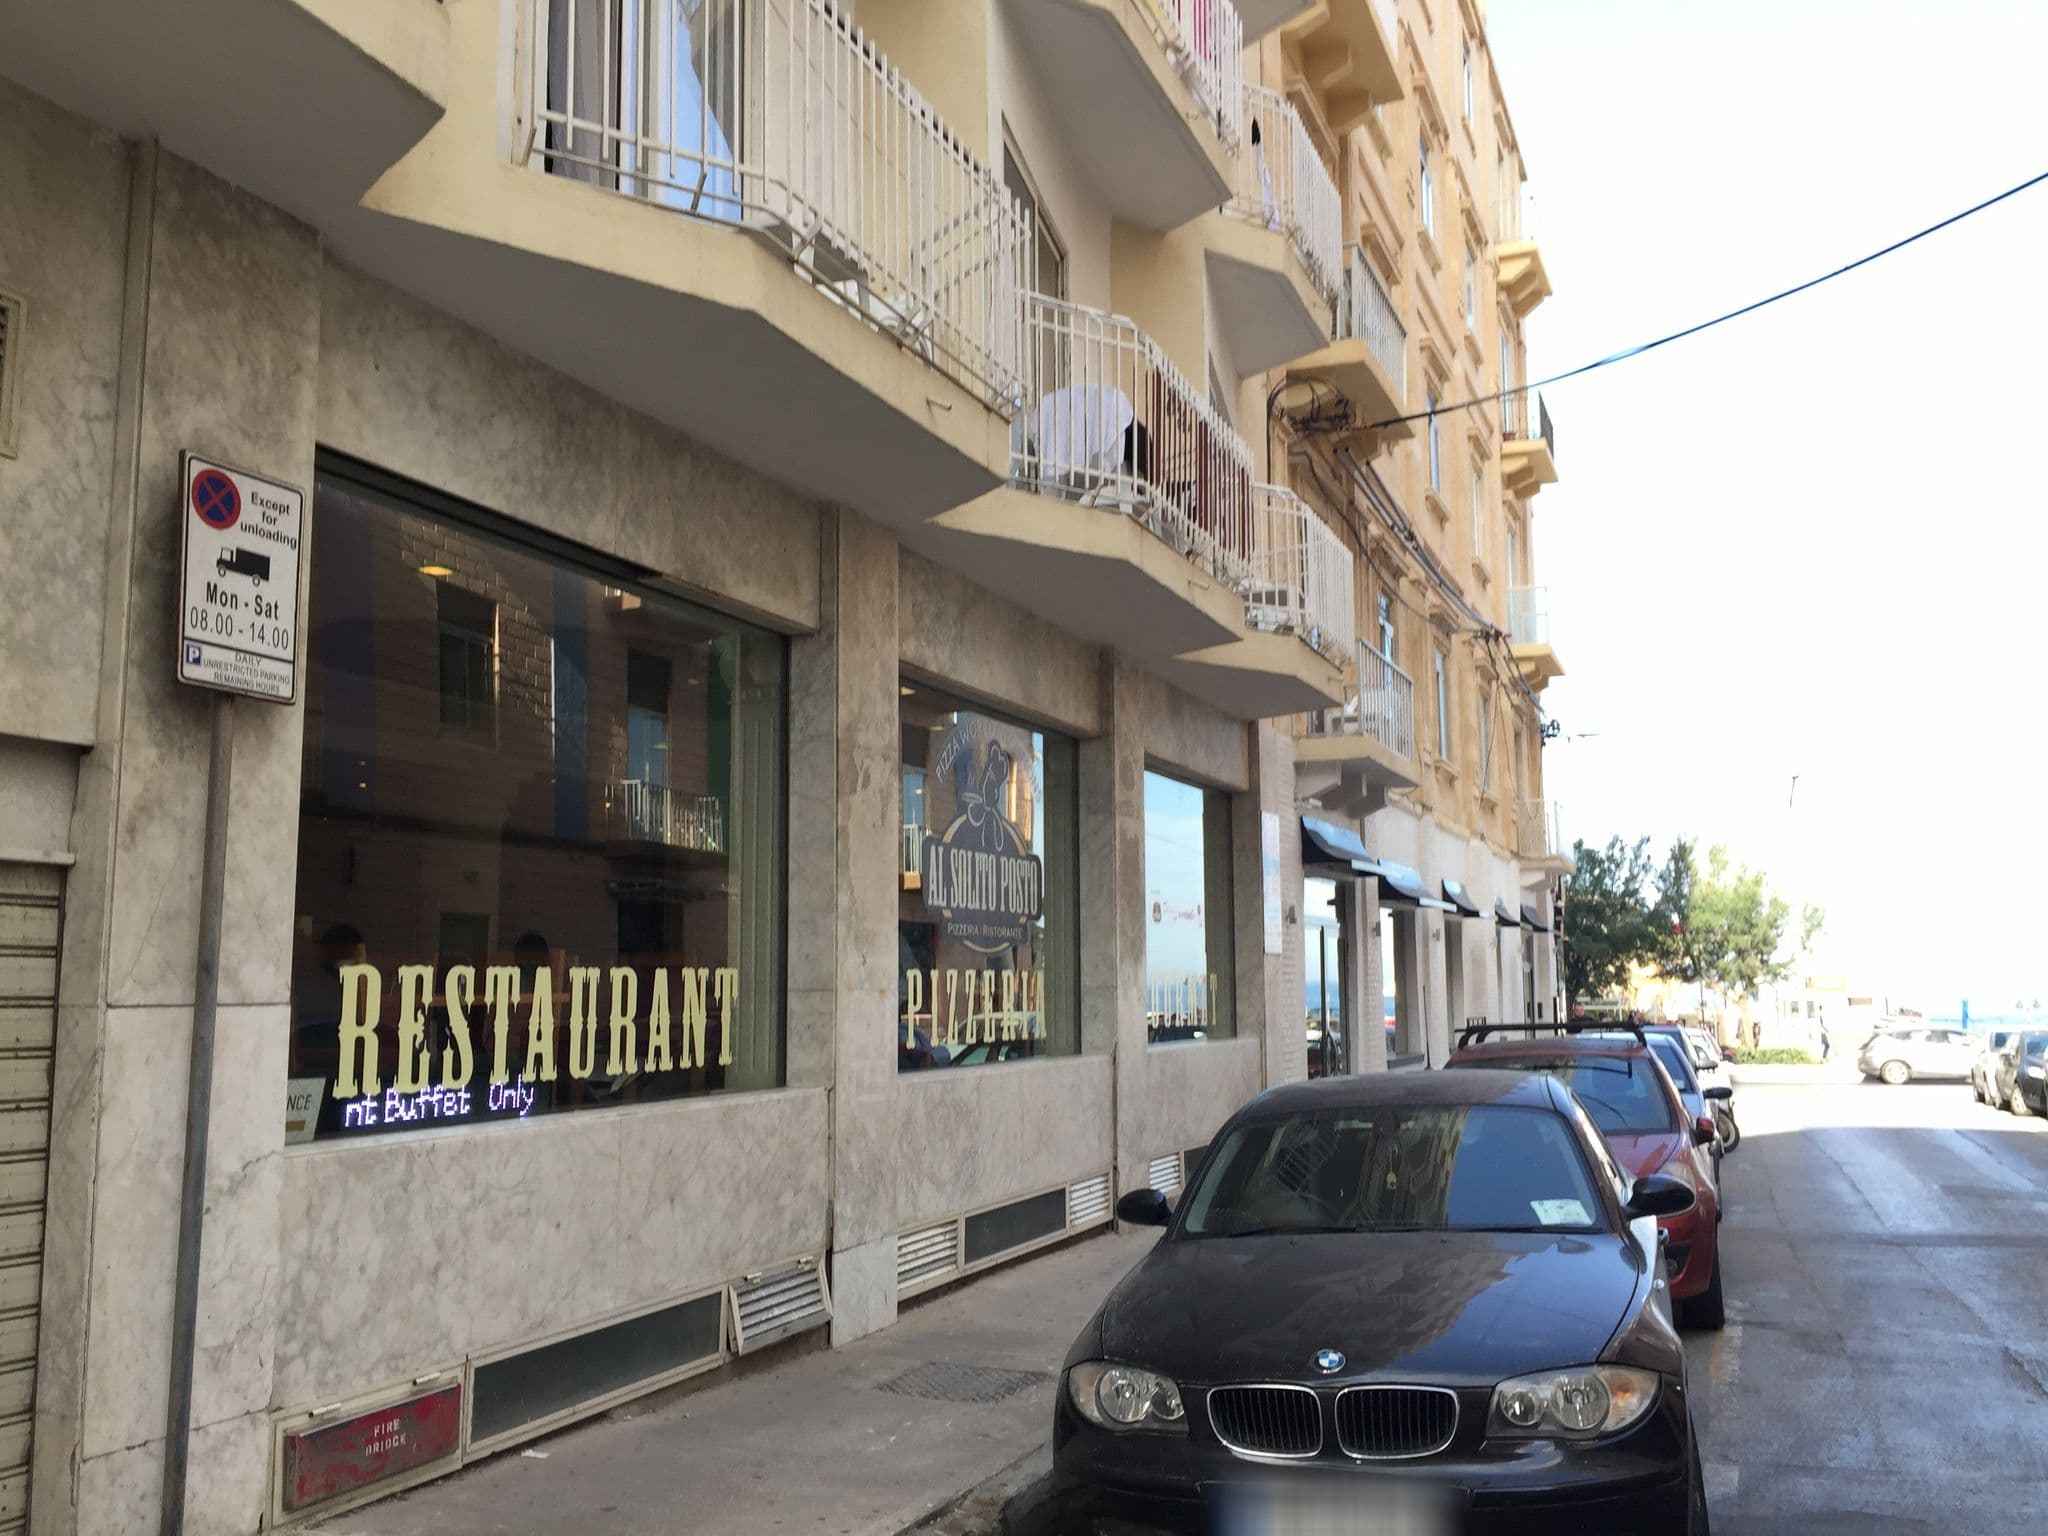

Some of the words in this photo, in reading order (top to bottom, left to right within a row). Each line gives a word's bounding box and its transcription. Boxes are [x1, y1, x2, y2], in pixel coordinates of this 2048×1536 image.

[250, 491, 291, 516] Except
[261, 511, 278, 526] for
[240, 522, 297, 550] unloading
[206, 582, 239, 610] Mon
[254, 595, 279, 621] Sat
[190, 606, 234, 637] 08.00
[249, 621, 290, 650] 14.00
[203, 658, 260, 678] UNRESTRICTED
[260, 671, 290, 685] PARKING
[234, 651, 262, 666] DAILY
[213, 671, 255, 689] REMAINING
[255, 683, 280, 695] HOURS
[935, 737, 961, 784] PIZZA
[928, 844, 947, 907] AL
[950, 848, 997, 912] SOLITO
[1000, 856, 1038, 916] POSTO
[947, 922, 979, 936] PIZZERIA
[983, 925, 1022, 939] RISTORANTE
[906, 967, 1047, 1050] PIZZERIA
[333, 963, 739, 1099] RESTAURANT
[384, 1084, 471, 1123] Buffet
[488, 1074, 534, 1117] Only
[374, 1417, 400, 1439] FIRE
